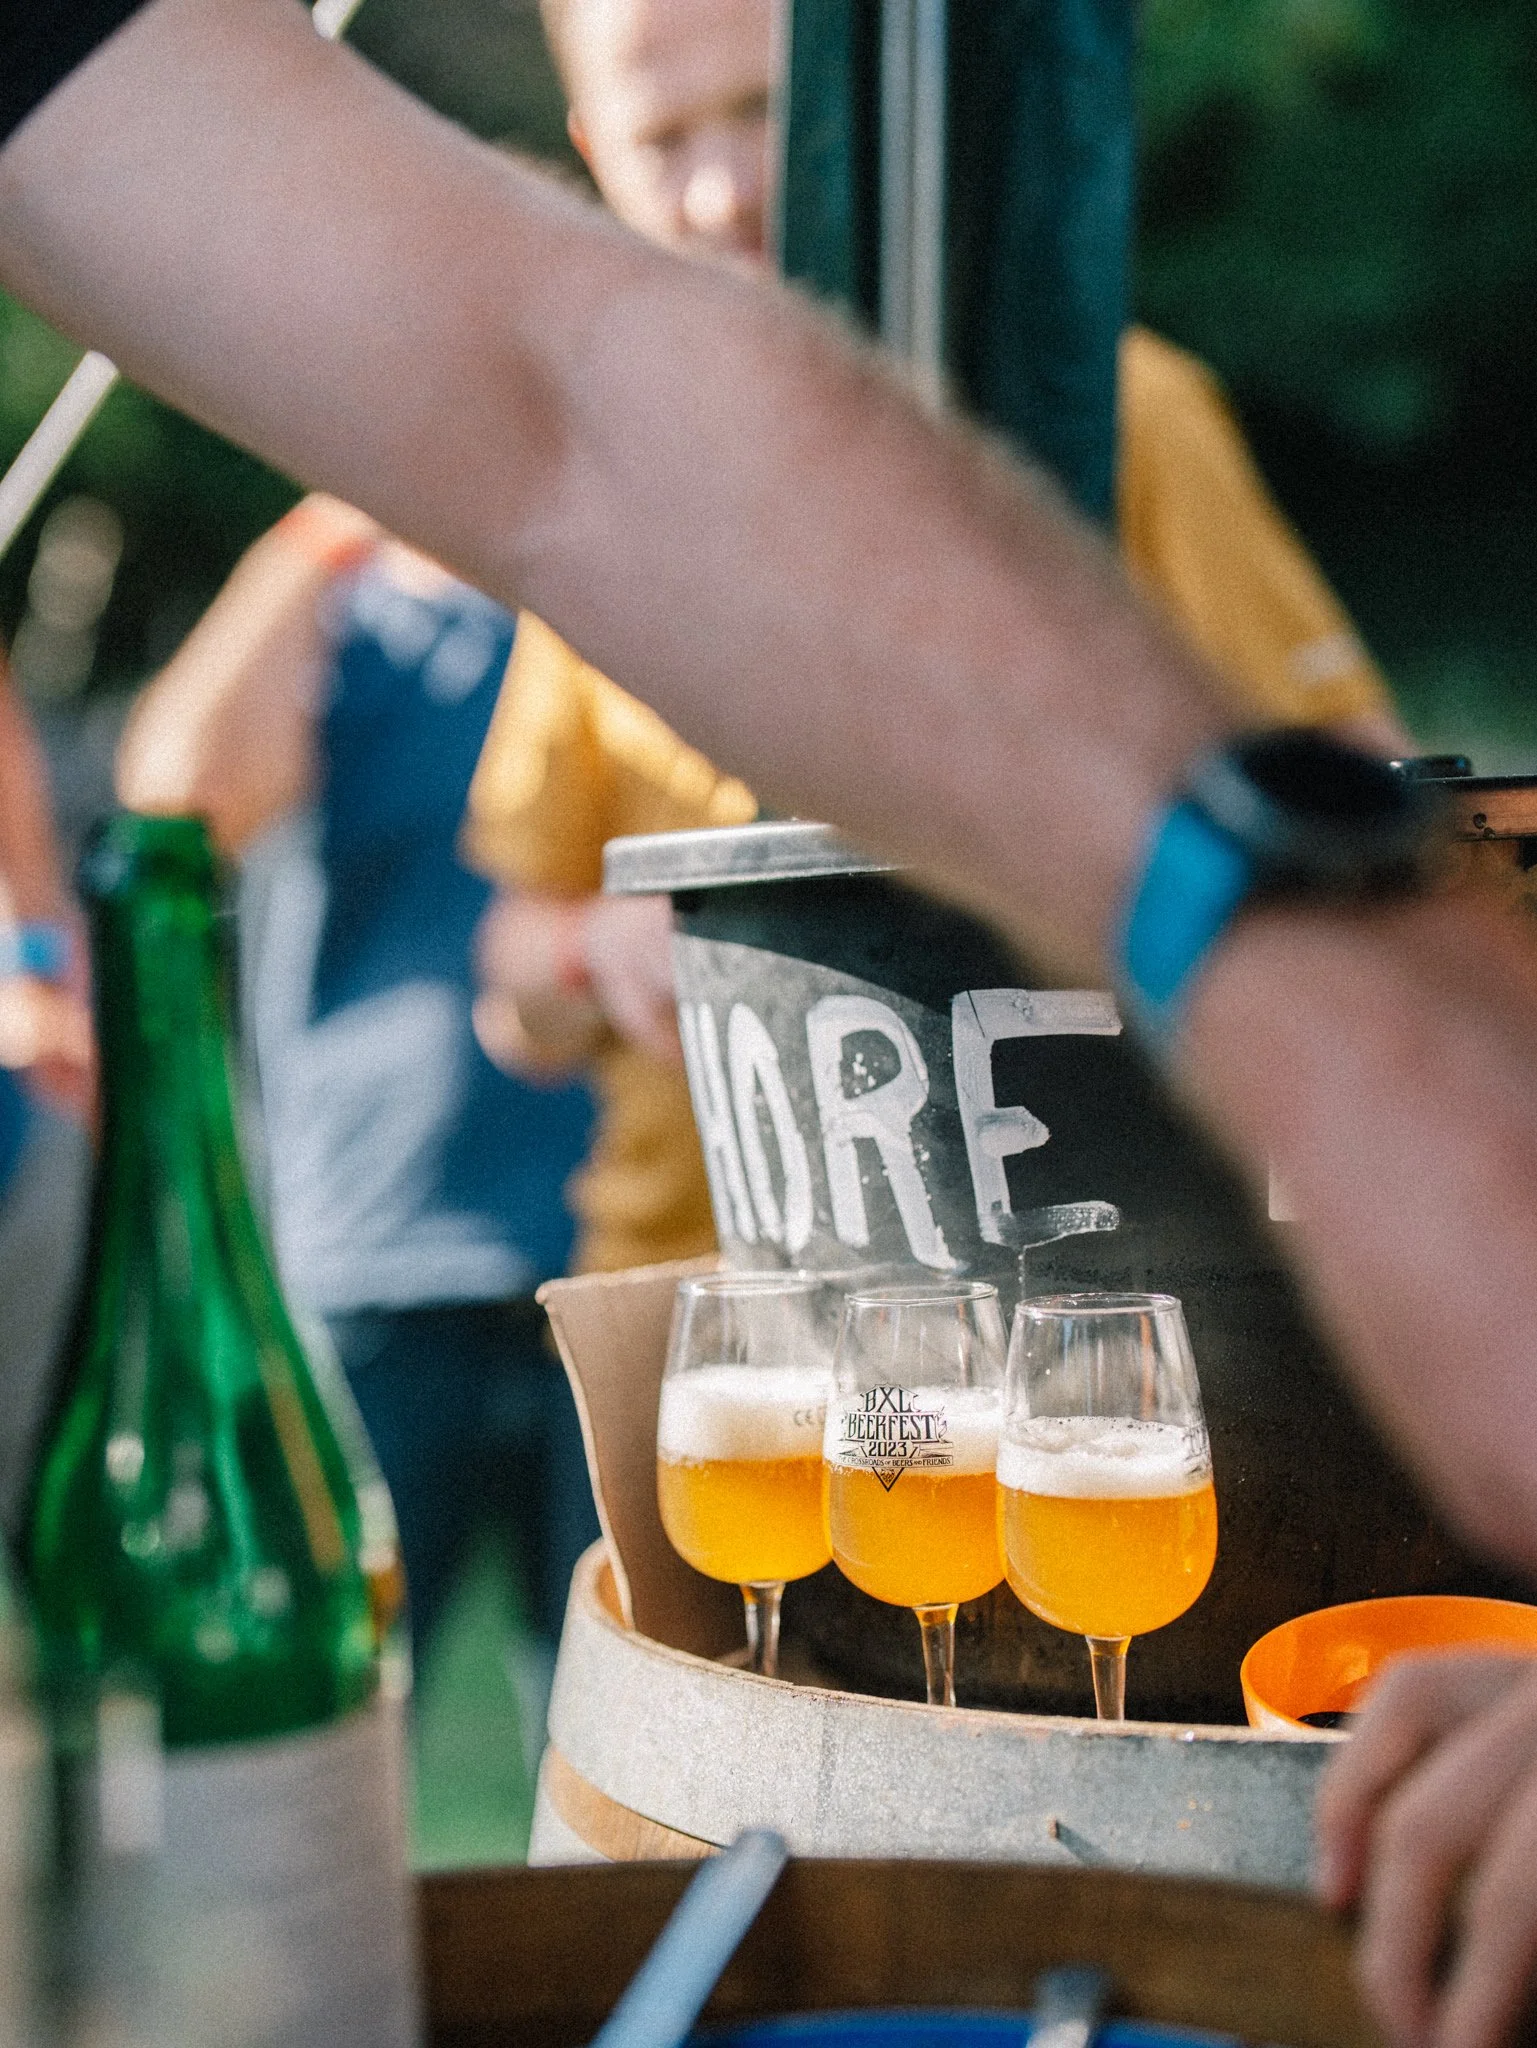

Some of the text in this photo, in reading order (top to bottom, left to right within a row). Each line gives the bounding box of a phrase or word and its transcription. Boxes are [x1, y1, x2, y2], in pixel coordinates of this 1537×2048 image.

[865, 1386, 914, 1413] BXL
[847, 1413, 935, 1441] BEERFEST
[868, 1441, 907, 1457] 2023
[892, 1459, 913, 1467] BEERS
[922, 1458, 951, 1466] FRIENDS
